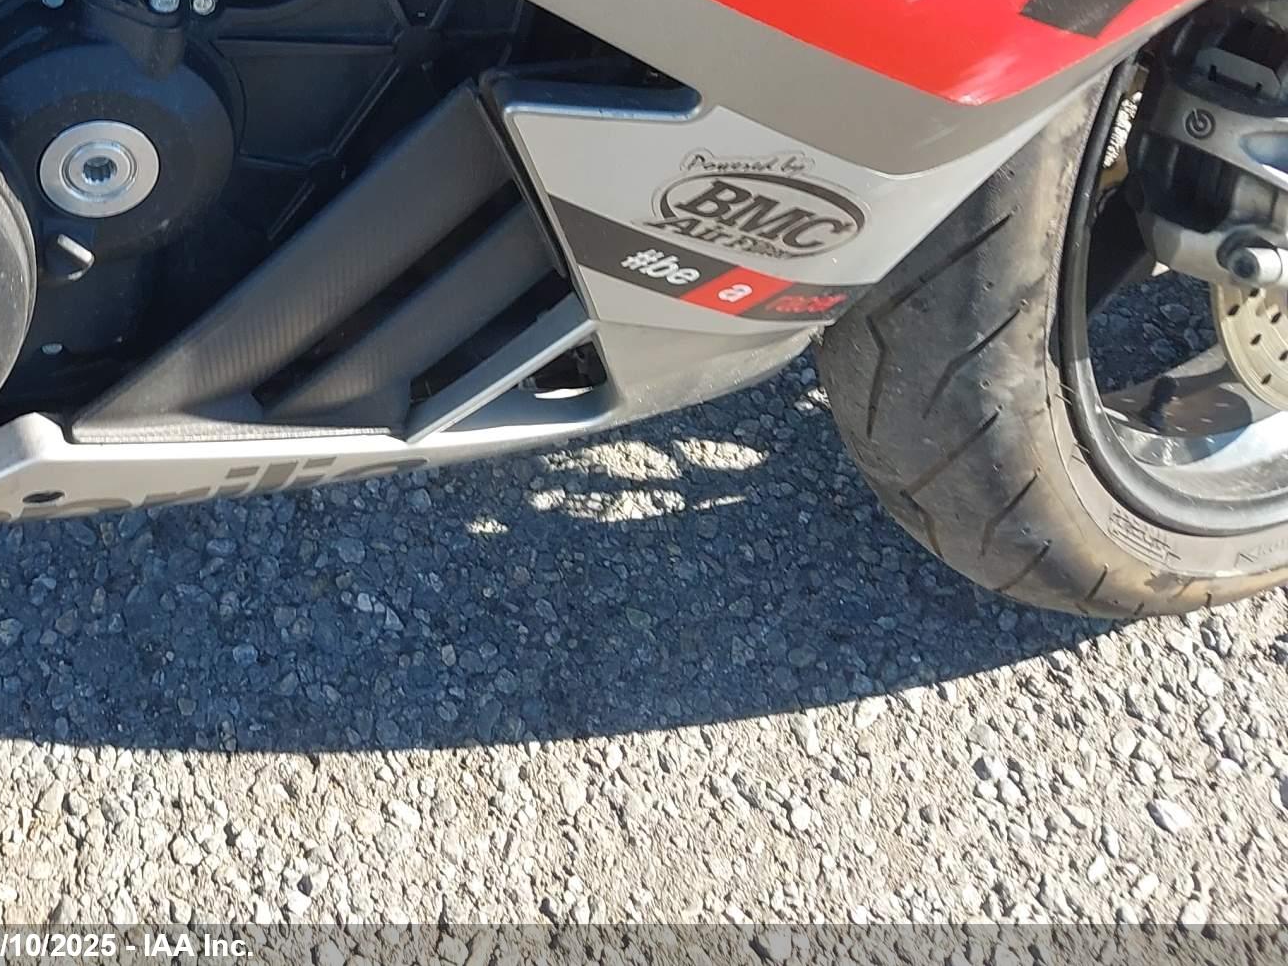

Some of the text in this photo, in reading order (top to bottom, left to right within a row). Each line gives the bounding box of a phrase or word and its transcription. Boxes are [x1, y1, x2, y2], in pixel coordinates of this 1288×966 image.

[675, 180, 855, 249] BMC
[620, 249, 701, 285] #be
[717, 283, 754, 304] a
